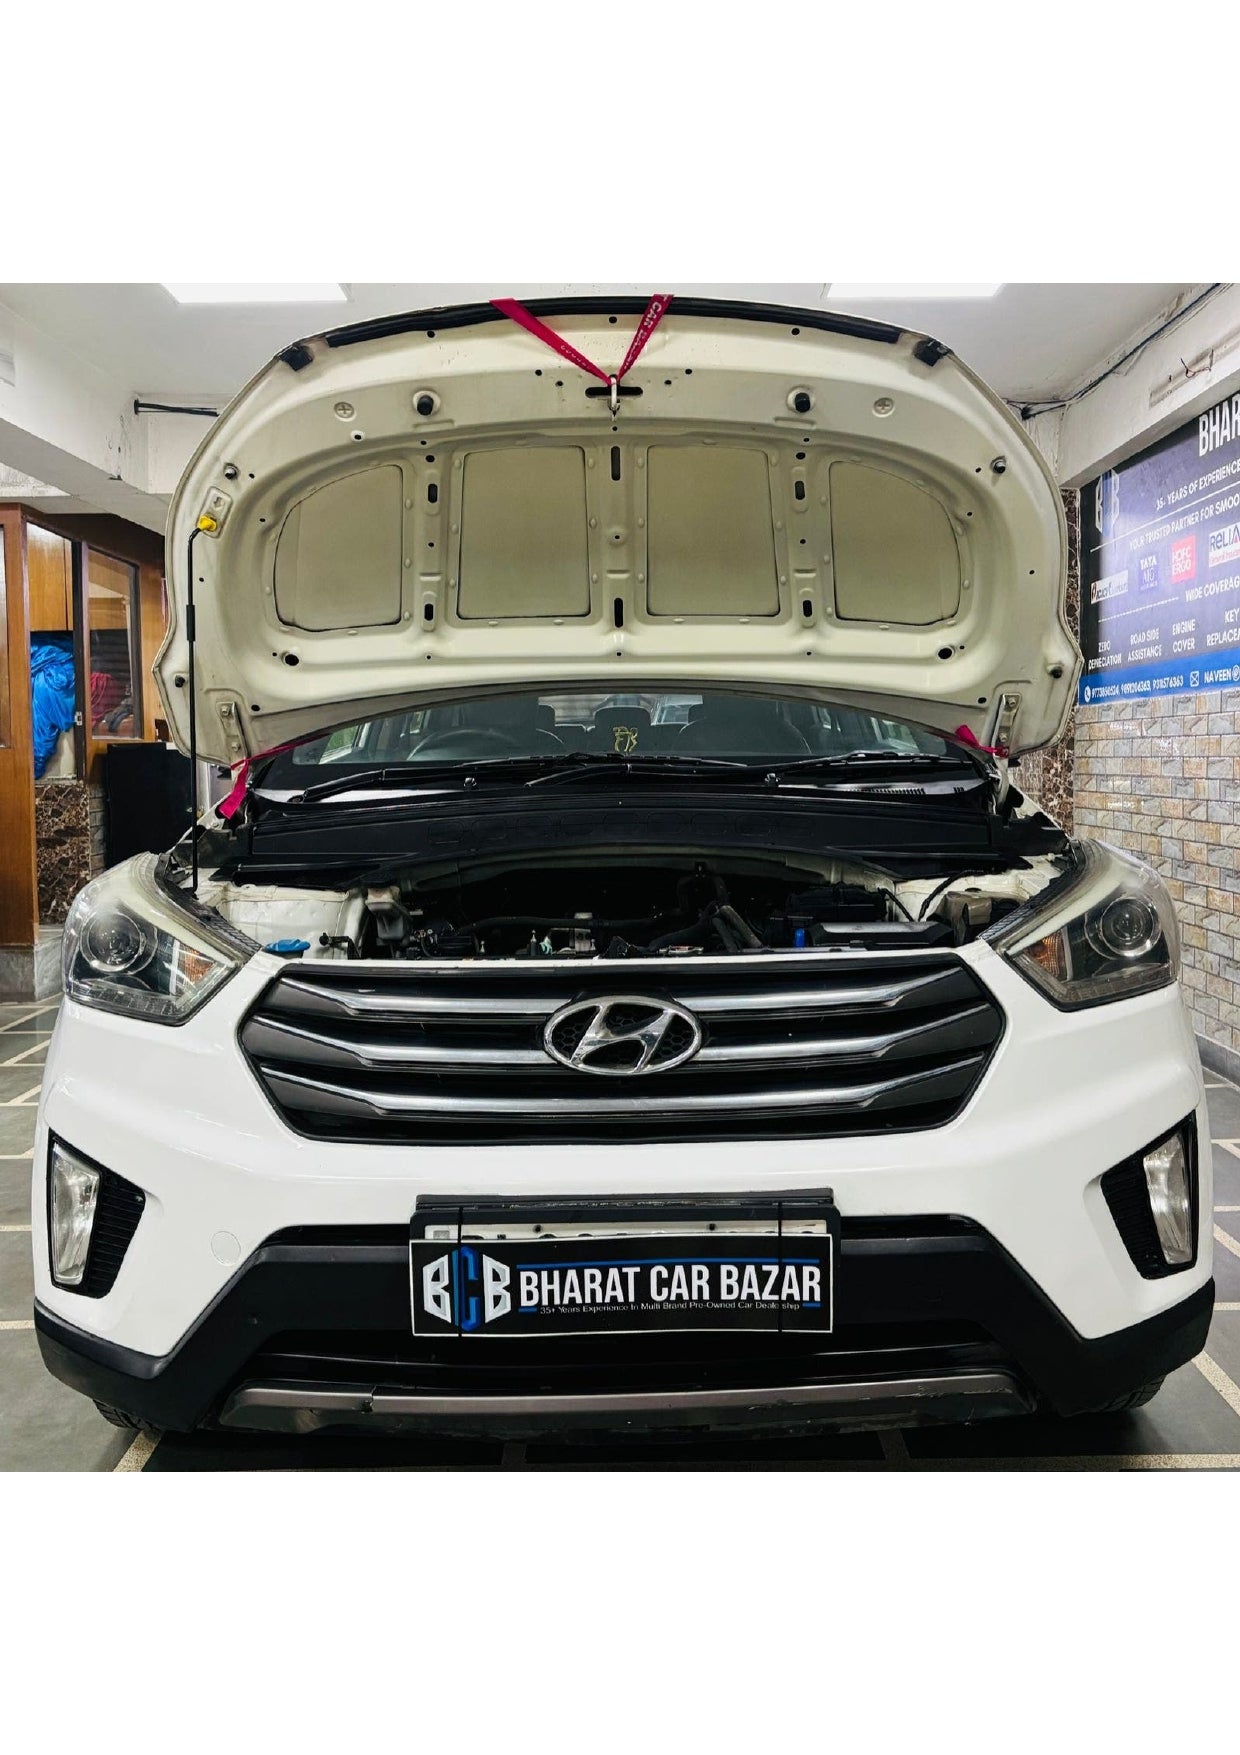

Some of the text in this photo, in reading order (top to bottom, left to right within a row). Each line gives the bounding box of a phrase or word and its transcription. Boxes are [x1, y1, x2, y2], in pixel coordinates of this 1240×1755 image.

[644, 302, 662, 328] CAR
[1167, 484, 1188, 504] YEARS
[1188, 479, 1200, 494] OF
[1146, 525, 1170, 543] TRUSTED
[1171, 511, 1199, 533] PARTNER
[1200, 504, 1214, 521] FOR
[1140, 554, 1157, 570] TATA
[1172, 546, 1190, 562] HDFC
[1172, 560, 1191, 577] ERGO
[1185, 588, 1202, 602] WIDE
[1224, 609, 1240, 623] KEY
[1172, 619, 1196, 636] ENGINE
[1130, 628, 1160, 646] ROAD SIDE
[1172, 638, 1196, 653] COVER
[1098, 640, 1111, 653] ZERO
[1127, 644, 1162, 662] ASSISTANCE
[1088, 653, 1122, 670] DEPRECIATION
[520, 1264, 821, 1307] BHARAT CAR BAZAR
[539, 1307, 556, 1315] 35+
[557, 1306, 581, 1314] Years
[582, 1304, 629, 1313] Experience
[641, 1302, 661, 1310] Multi
[663, 1302, 687, 1310] Brand
[690, 1301, 736, 1309] Pre-Owned
[738, 1301, 753, 1309] Car
